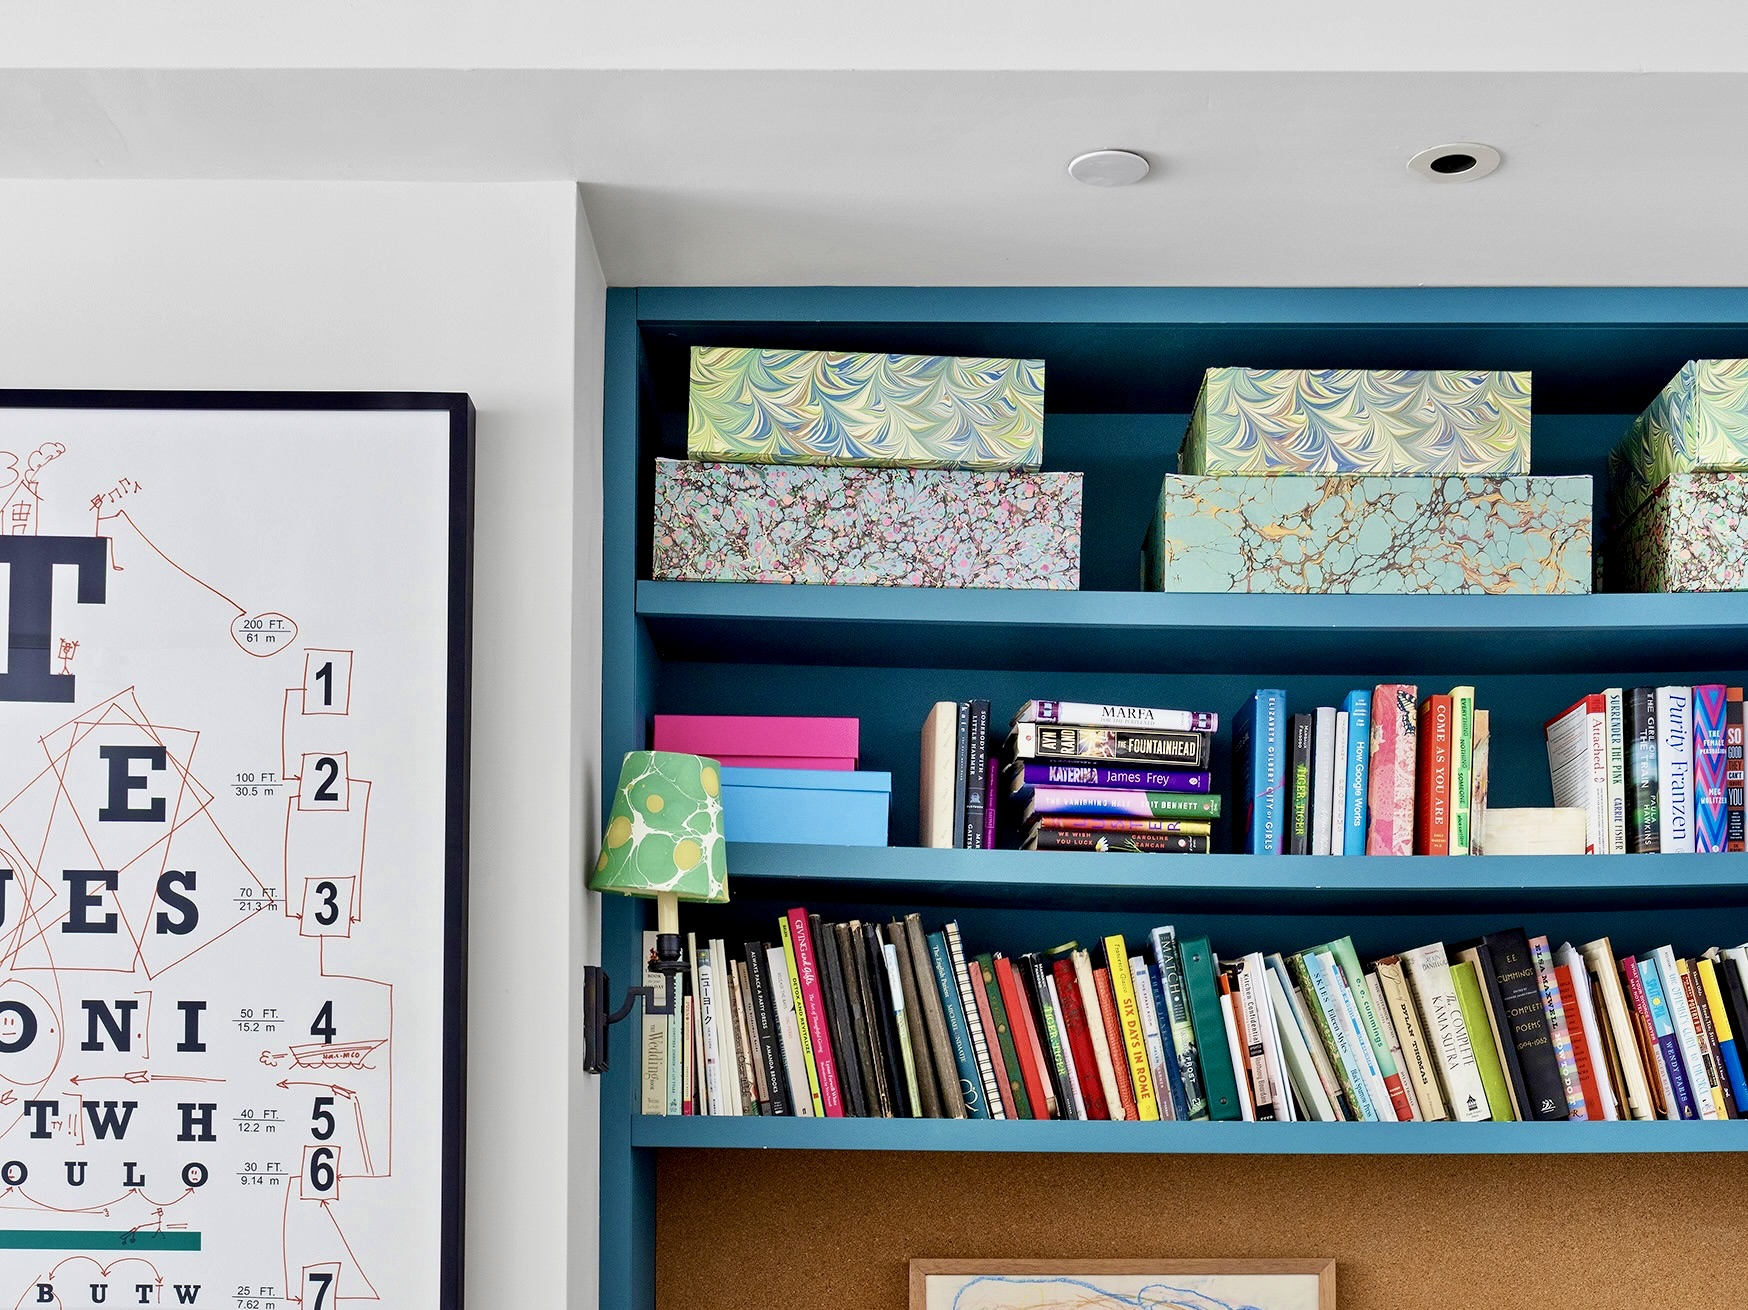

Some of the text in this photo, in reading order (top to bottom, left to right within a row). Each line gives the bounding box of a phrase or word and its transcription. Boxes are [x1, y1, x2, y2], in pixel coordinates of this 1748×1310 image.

[243, 619, 285, 630] 200 FT.
[246, 633, 276, 643] 61 m
[315, 662, 333, 706] 1
[1101, 706, 1155, 720] MARFA
[1267, 697, 1276, 742] ELIZABETH
[1435, 704, 1447, 741] COME
[978, 711, 986, 751] SOMEBODY
[1041, 731, 1057, 750] AYN
[1060, 729, 1075, 755] RAND
[1708, 730, 1720, 738] THE
[1727, 728, 1742, 744] SO
[1117, 738, 1196, 756] THE FOUNTAINHEAD
[1354, 741, 1365, 762] How
[1590, 718, 1604, 773] Attached.
[1648, 744, 1655, 759] ON
[1703, 739, 1725, 747] FEMALE
[1727, 746, 1742, 759] GOOD
[969, 743, 977, 775] HAMMER
[1265, 746, 1275, 782] GILBERT
[1436, 746, 1445, 763] AS
[1639, 728, 1649, 788] THE TRAIN
[1728, 760, 1742, 770] THEY
[1049, 766, 1170, 787] KATERINA James Frey
[1609, 695, 1623, 849] SURRENDER THE PINK CARRIE FISHER
[1664, 694, 1690, 839] Purity Franzen
[99, 746, 167, 822] E
[235, 773, 277, 783] 100 FT.
[314, 757, 339, 801] 2
[1351, 763, 1365, 796] Google
[1434, 767, 1445, 793] YOU
[235, 786, 274, 797] 30.5 m
[1265, 786, 1274, 810] CITY
[1708, 788, 1722, 796] MEG
[1728, 788, 1743, 806] YOU
[1046, 797, 1061, 806] THE
[1063, 798, 1108, 807] VANISHING
[1111, 800, 1131, 808] HALF
[1161, 801, 1198, 810] BENNETT
[1352, 797, 1363, 826] Works
[1434, 797, 1444, 825] ARE
[1643, 804, 1651, 844] HAWKINS
[1056, 838, 1072, 846] YOU
[1131, 834, 1169, 842] CAROLINE
[1263, 821, 1273, 850] GIRLS
[239, 888, 278, 898] 70 FT.
[314, 881, 339, 925] 3
[239, 901, 278, 911] 21.3 m
[749, 951, 759, 973] ALWAYS
[931, 944, 941, 958] The
[934, 957, 946, 978] English
[1160, 940, 1181, 996] MATCH
[1497, 967, 1534, 984] CUMMINGS
[753, 973, 761, 989] PACK
[940, 977, 951, 998] Patient
[1242, 973, 1253, 1000] Kitchen
[698, 972, 714, 1025] ニューヨーク
[757, 995, 765, 1011] PARTY
[1628, 962, 1656, 1041] WHAT YOUR DIVORCE LAWYER
[240, 1009, 279, 1019] 50 FT.
[310, 1000, 337, 1045] 4
[759, 1012, 768, 1029] DRESS
[791, 977, 810, 1054] DETOX AND REVITALIZE
[1247, 1001, 1263, 1044] Confidential
[1313, 972, 1330, 1003] SKIES
[1327, 1008, 1340, 1032] Eileen
[1335, 1032, 1349, 1055] Myles
[1355, 977, 1384, 1048] e. e. cummings
[237, 1023, 260, 1032] 15.2
[1444, 992, 1475, 1067] The COMPLETE
[1515, 1020, 1541, 1034] POEMS
[1534, 944, 1577, 1106] ELSA MAXWELL HOW TO DO IT
[1122, 997, 1150, 1099] SIX DAYS IN ROME
[1399, 1003, 1429, 1084] DYLAN THOMAS
[765, 1044, 774, 1070] AMANDA
[769, 1070, 778, 1093] BROOKS
[1665, 1040, 1687, 1102] WENDY PARIS
[240, 1109, 279, 1119] 40 FT.
[311, 1097, 336, 1141] 5
[237, 1123, 276, 1133] 12.2 m
[244, 1162, 283, 1172] 30 FT.
[310, 1147, 334, 1191] 6
[241, 1176, 280, 1186] 9.14 m
[237, 1286, 276, 1297] 25 FT.
[237, 1300, 275, 1310] 7.62 m
